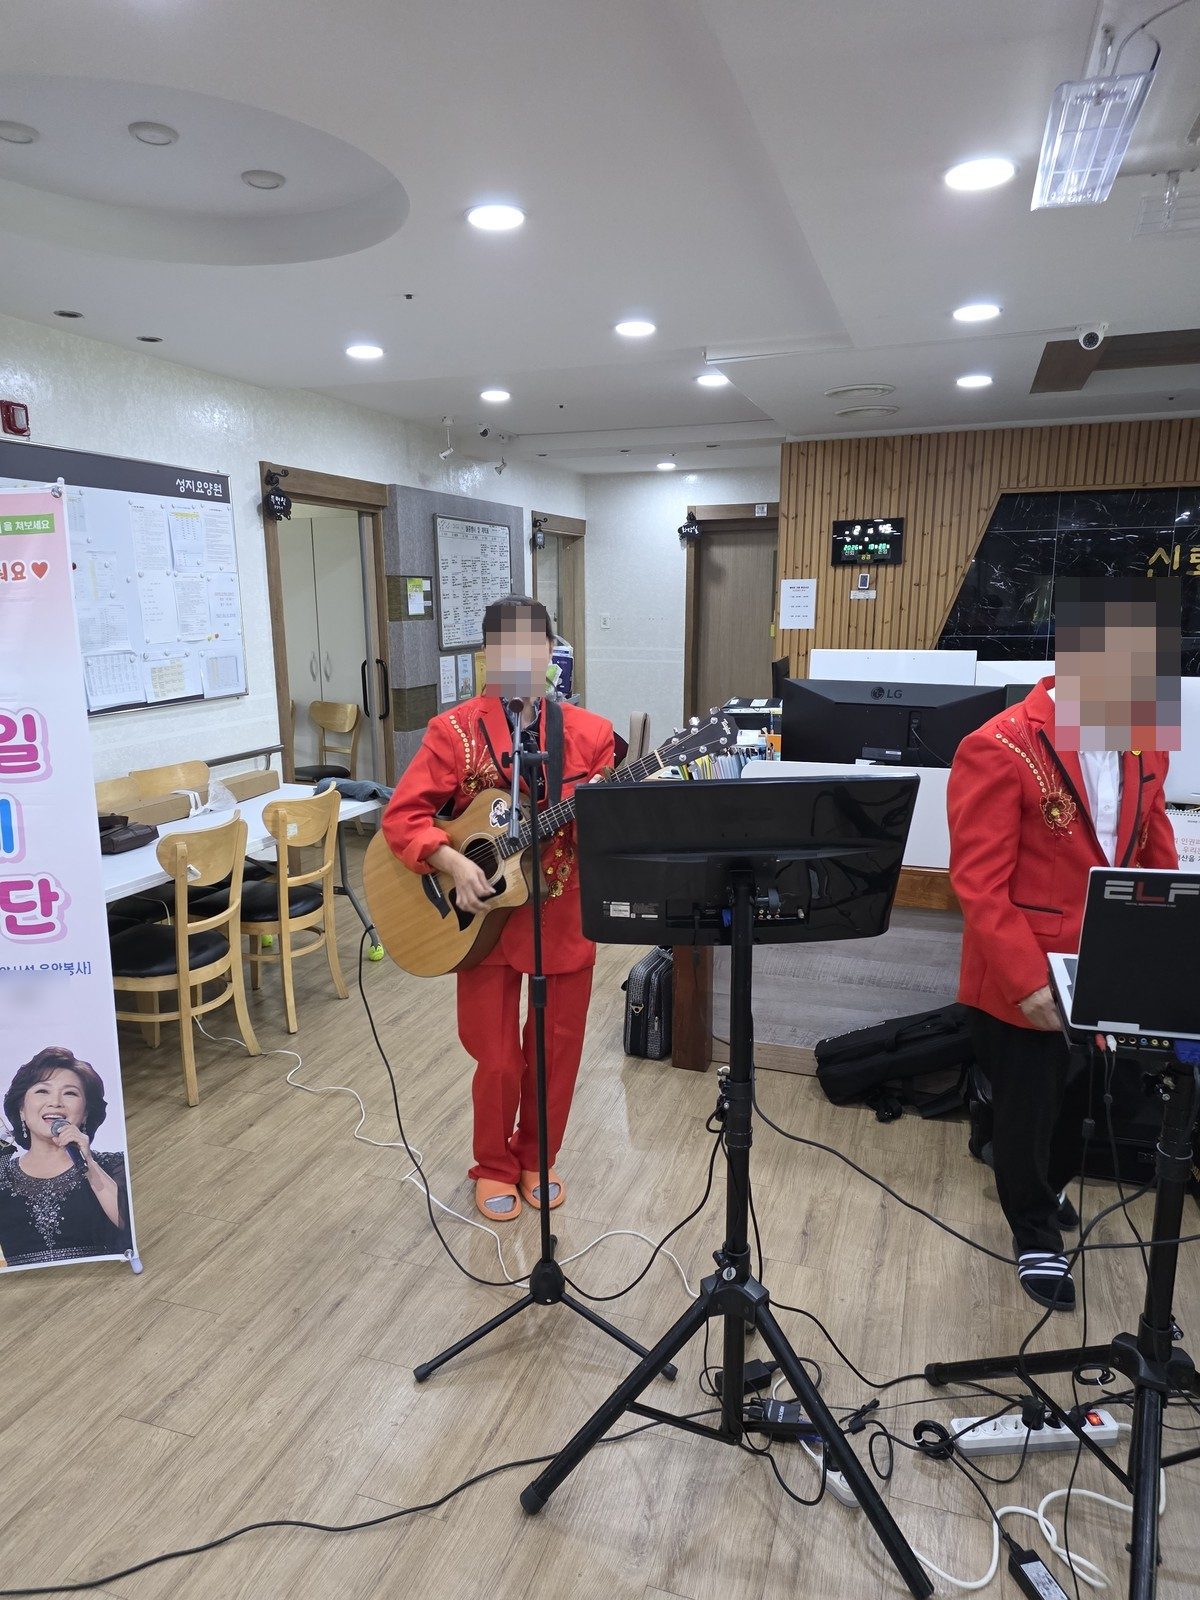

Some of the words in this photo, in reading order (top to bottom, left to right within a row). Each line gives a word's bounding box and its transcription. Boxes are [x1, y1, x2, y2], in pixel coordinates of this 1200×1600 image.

[176, 479, 222, 496] 성지요양원
[1147, 544, 1200, 577] 신
[887, 689, 902, 698] LG
[0, 878, 60, 936] 단
